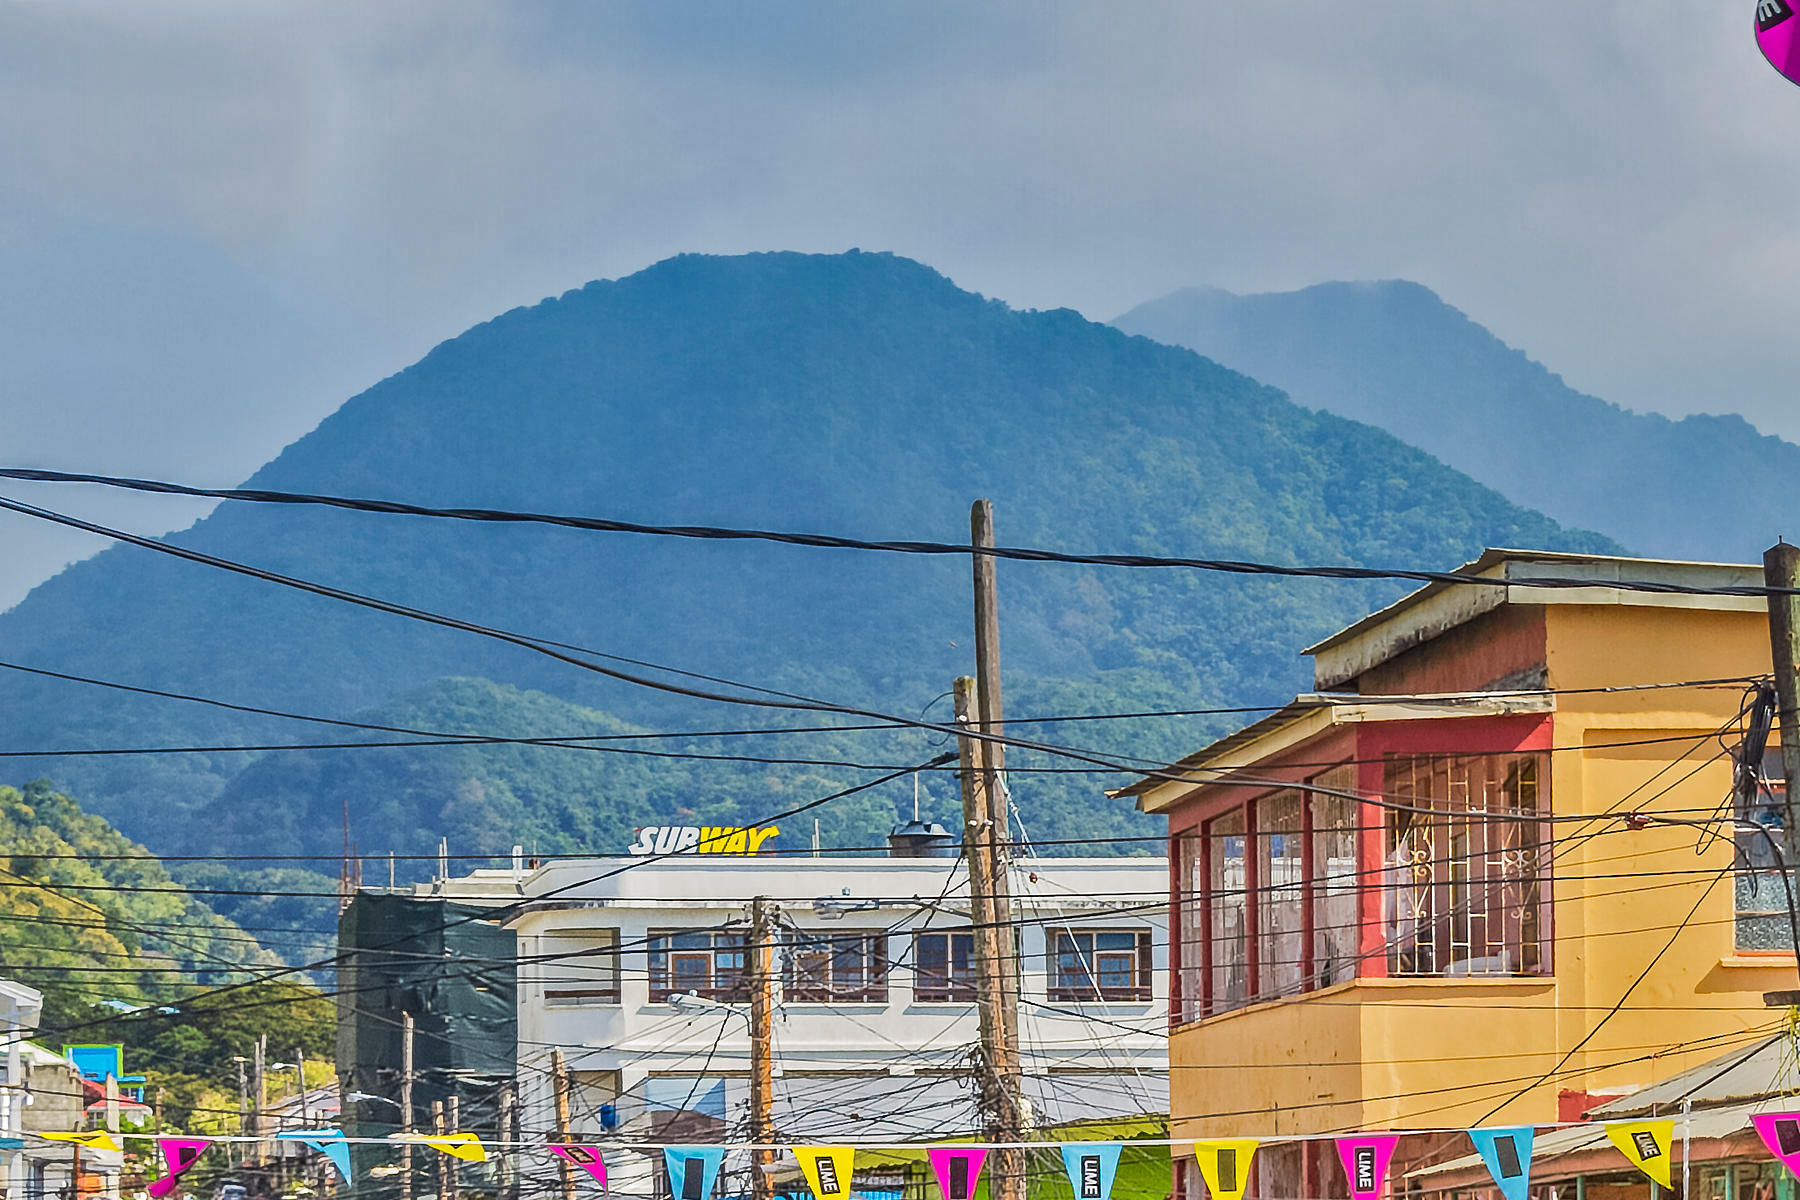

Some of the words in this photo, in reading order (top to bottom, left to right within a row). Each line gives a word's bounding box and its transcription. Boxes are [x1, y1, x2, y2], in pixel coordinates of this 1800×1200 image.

[628, 825, 780, 857] SUBWAY
[1635, 1134, 1658, 1157] LIME
[818, 1160, 838, 1191] LIME
[1084, 1160, 1098, 1195] LIME
[1358, 1152, 1372, 1188] LIME
